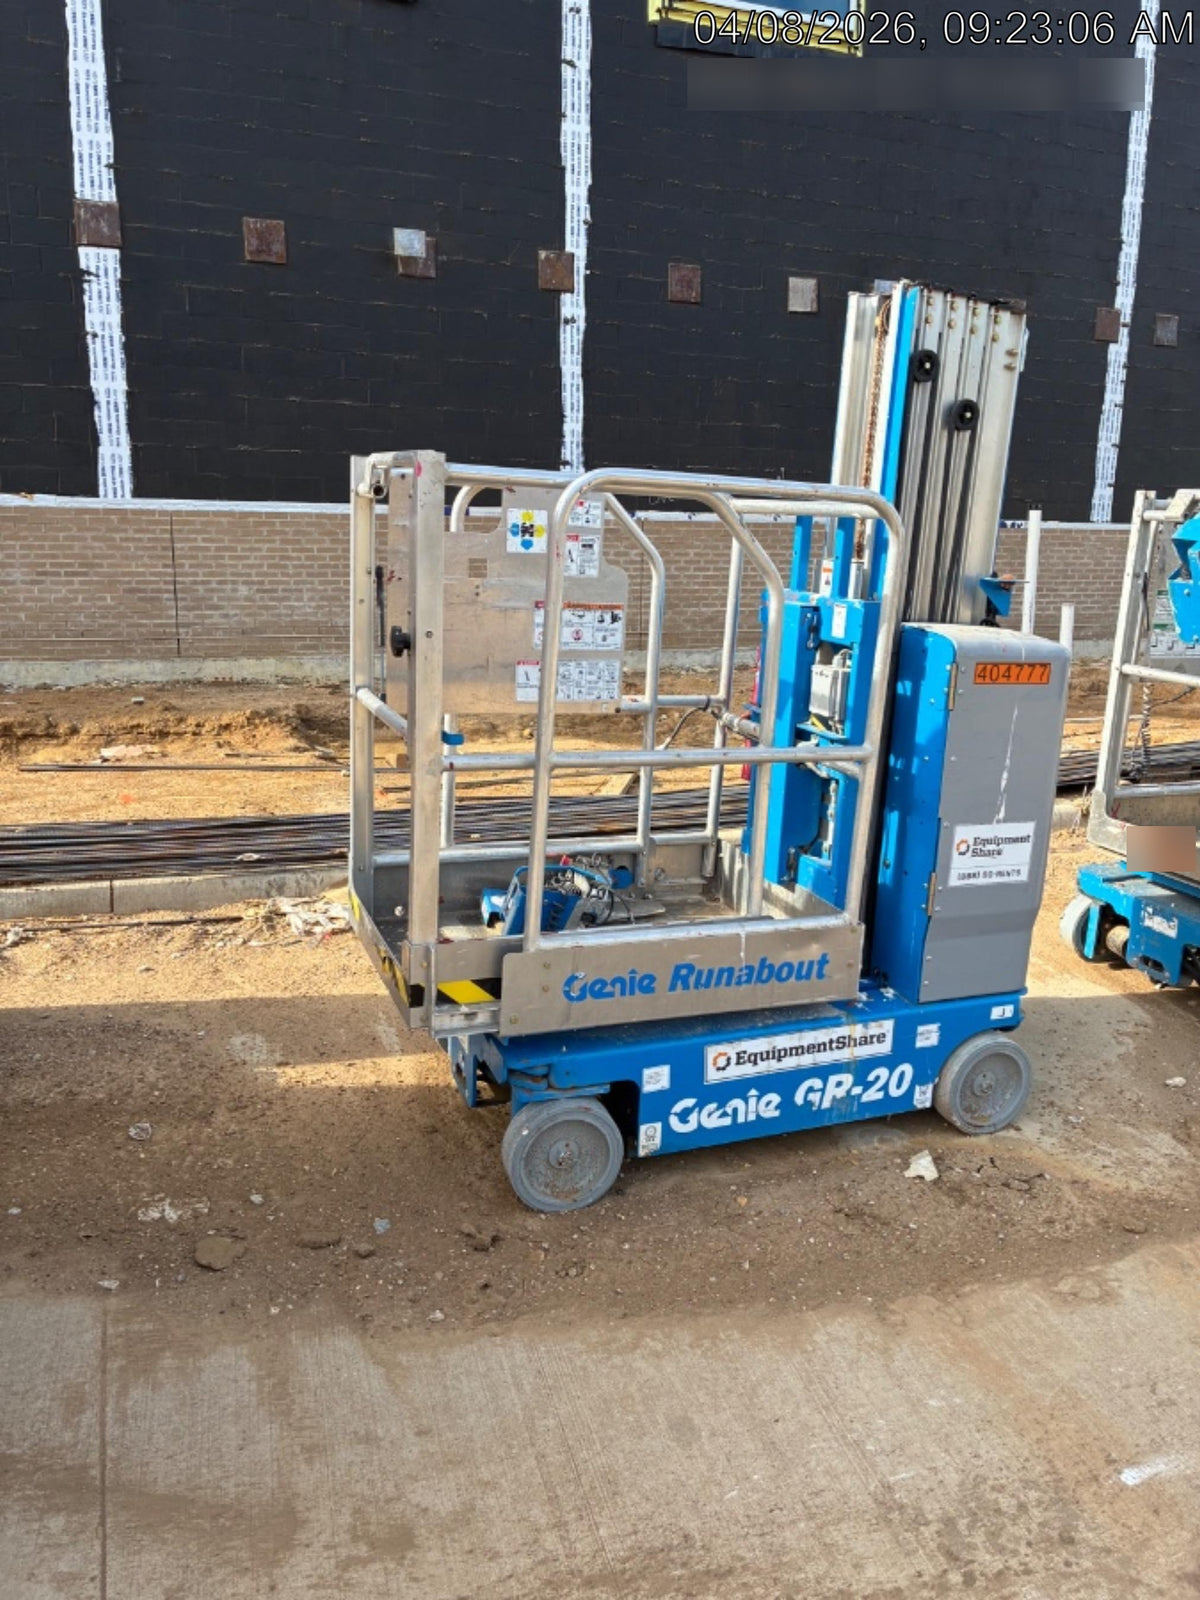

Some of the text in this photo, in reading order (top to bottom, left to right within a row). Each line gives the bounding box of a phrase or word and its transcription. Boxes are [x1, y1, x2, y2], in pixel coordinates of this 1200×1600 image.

[977, 664, 1048, 682] 404777
[970, 847, 1003, 858] Share
[972, 834, 1031, 848] Equipment
[563, 953, 831, 1003] Genie Runabout
[734, 1031, 887, 1067] EquipmentShare
[668, 1088, 782, 1134] Genie
[794, 1062, 914, 1111] GR-20
